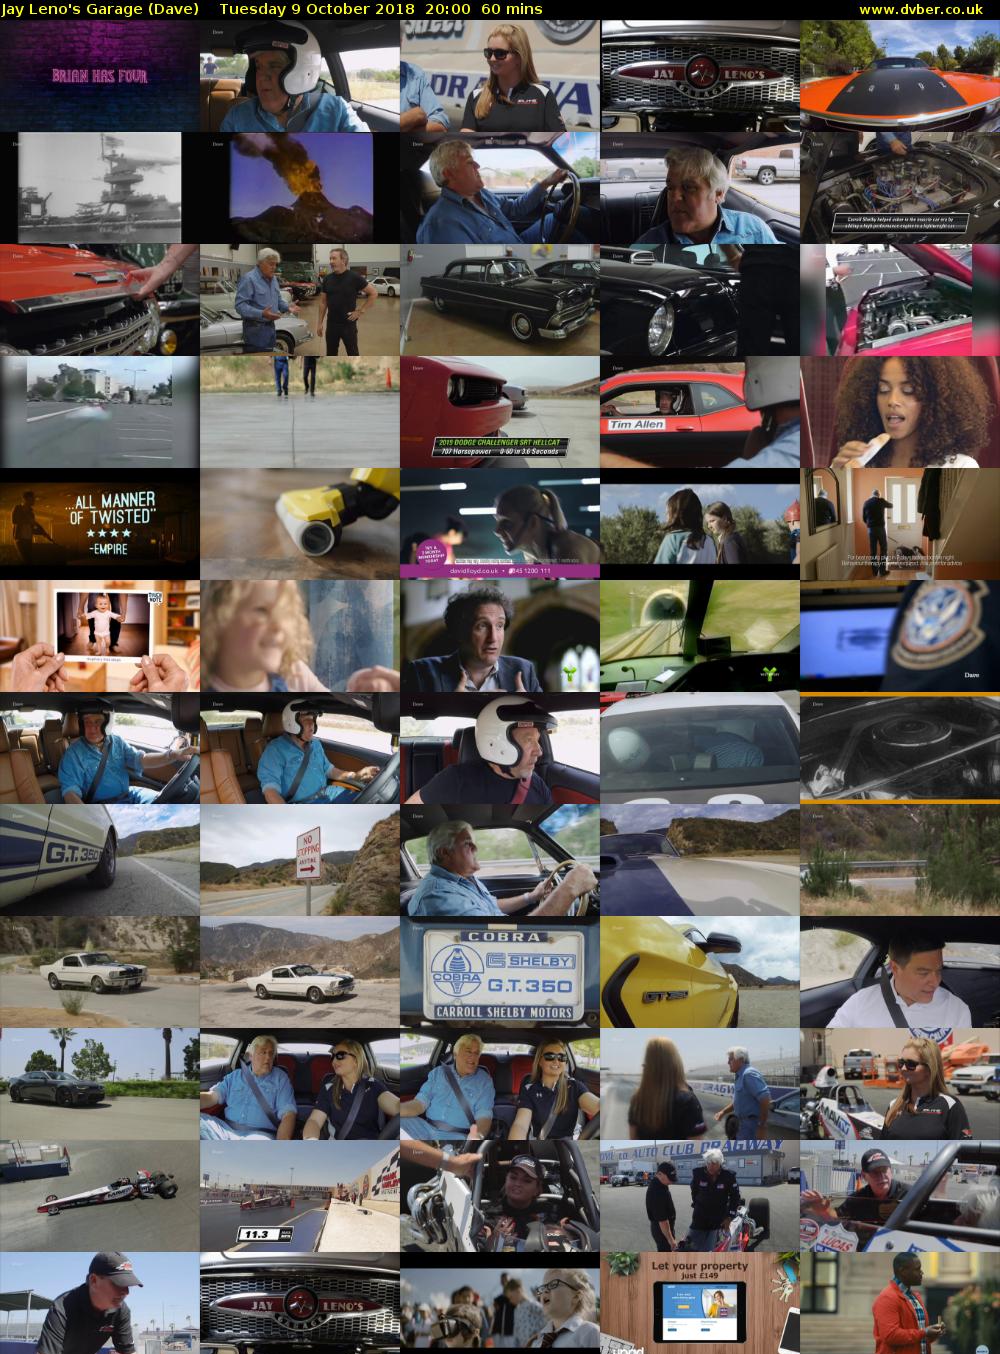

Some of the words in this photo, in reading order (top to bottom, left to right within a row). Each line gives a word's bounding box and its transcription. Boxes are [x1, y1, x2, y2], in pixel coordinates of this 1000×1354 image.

[52, 69, 89, 83] BRIAN
[92, 69, 115, 83] HAS
[118, 69, 148, 84] FOUR
[653, 70, 675, 80] JAY
[724, 69, 765, 80] LENO'S
[610, 420, 632, 429] Tim
[635, 420, 664, 429] Allen
[101, 491, 156, 508] MANNER
[70, 511, 84, 525] OF
[303, 835, 313, 845] NO
[46, 842, 99, 864] G.T.350
[468, 932, 540, 942] COBRA
[510, 956, 570, 968] SHELBY
[432, 973, 481, 982] COBRA
[488, 978, 573, 993] G.T.350
[436, 1006, 481, 1018] CARROLL
[487, 1006, 526, 1019] SHELBY
[530, 1007, 572, 1019] MOTORS
[632, 1145, 657, 1159] AUTO
[663, 1142, 695, 1157] CLUB
[251, 1301, 273, 1311] JAY
[323, 1301, 364, 1311] LENO'S
